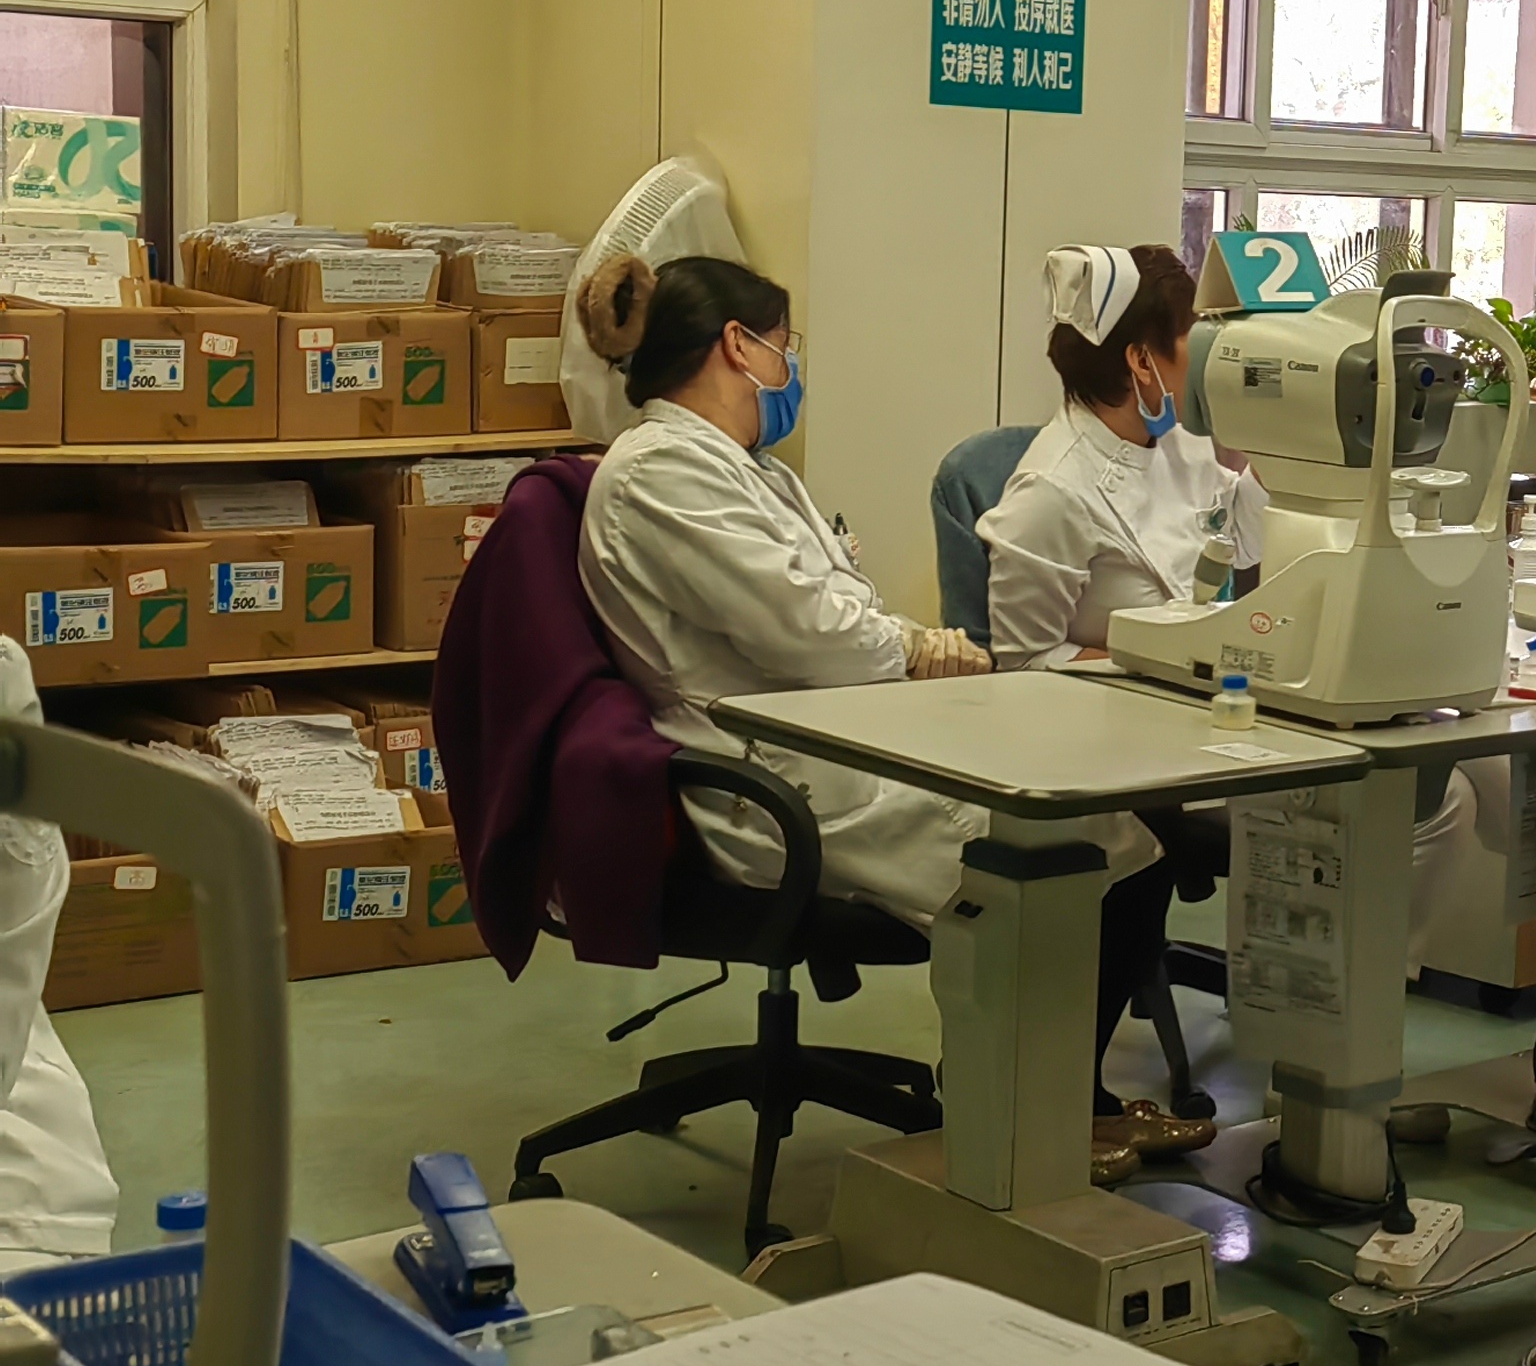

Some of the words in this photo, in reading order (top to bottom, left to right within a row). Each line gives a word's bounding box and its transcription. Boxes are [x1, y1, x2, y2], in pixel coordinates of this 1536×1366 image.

[940, 41, 1004, 87] 安静等候
[1012, 47, 1074, 90] 利人利己
[1244, 237, 1315, 302] 2
